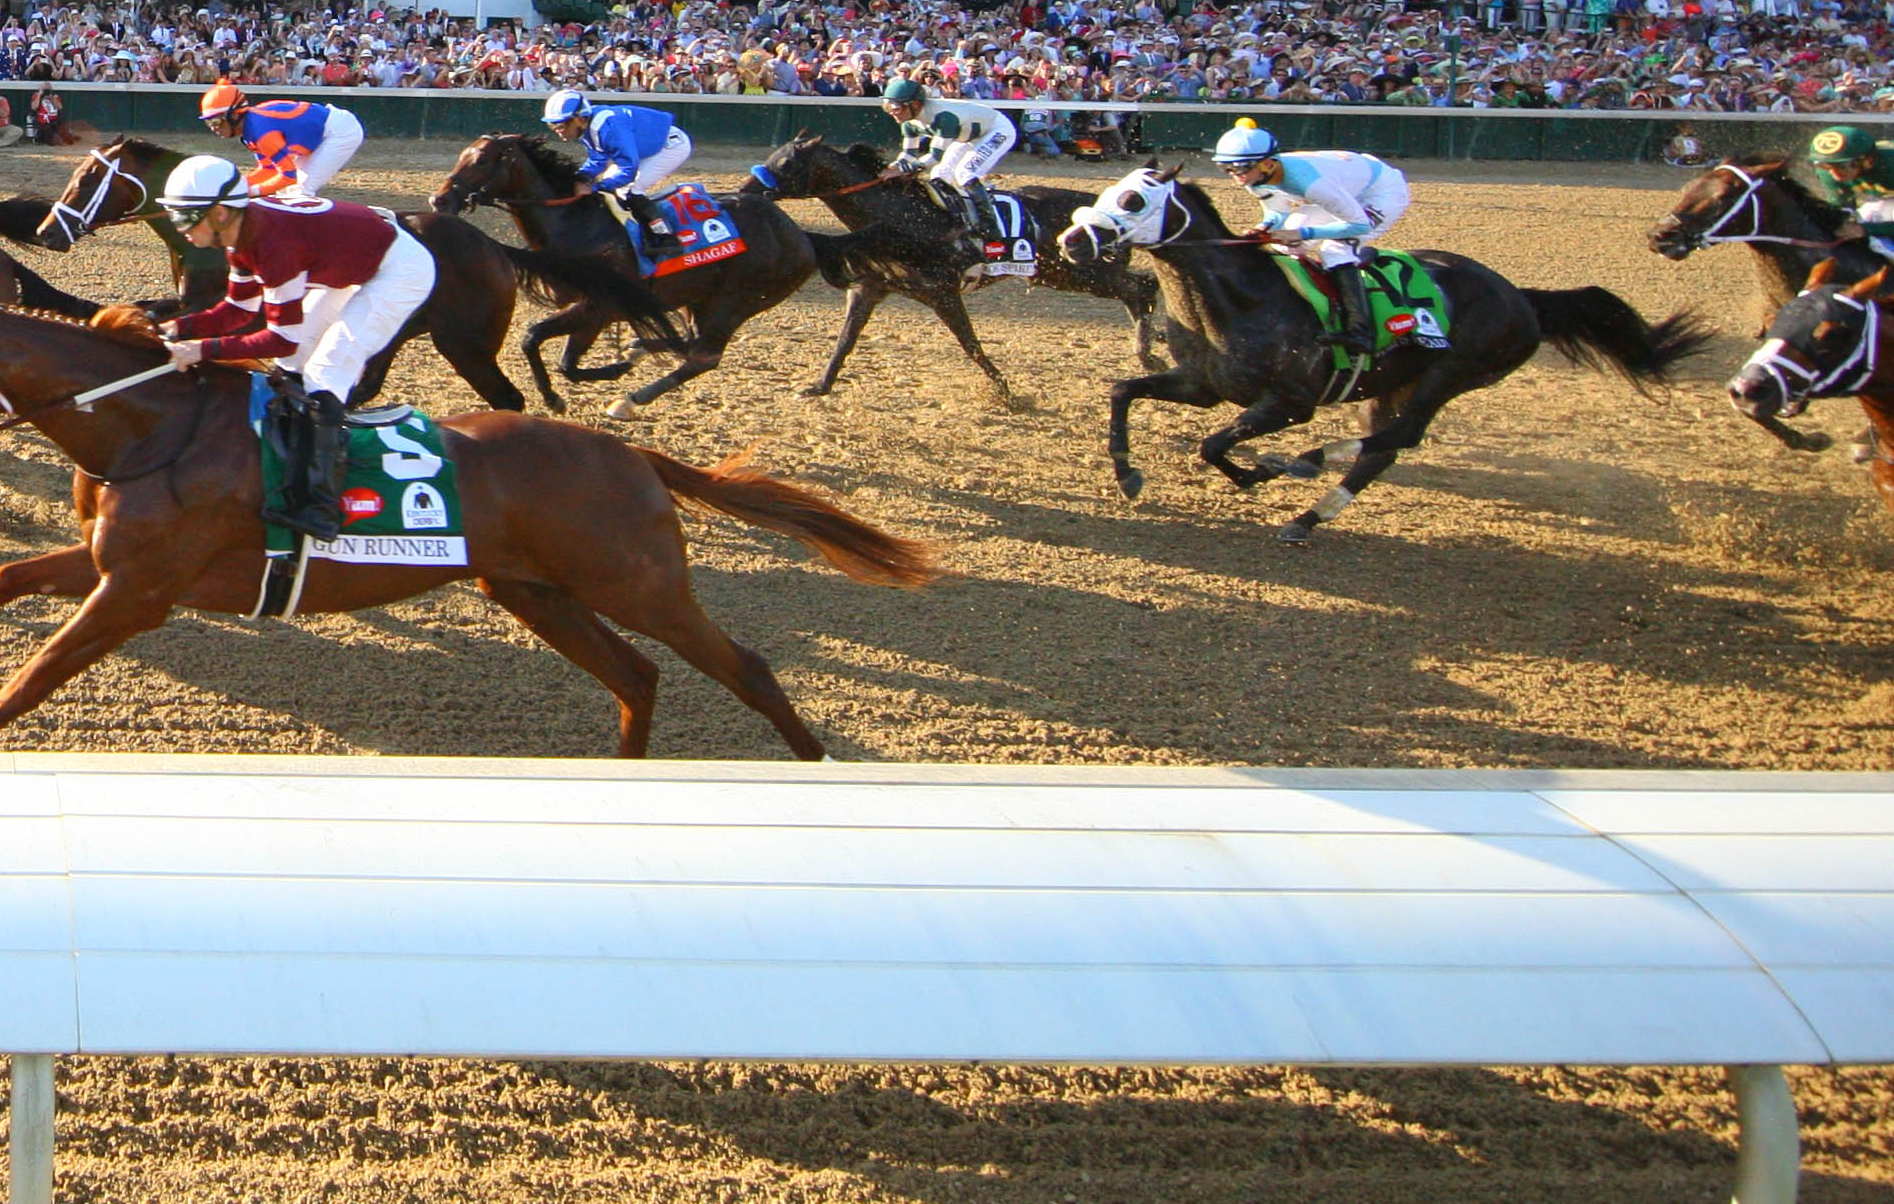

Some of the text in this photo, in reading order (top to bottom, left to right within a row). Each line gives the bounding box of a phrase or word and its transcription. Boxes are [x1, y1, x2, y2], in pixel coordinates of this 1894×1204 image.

[683, 242, 738, 266] SHAGAF
[375, 416, 444, 480] 5
[342, 495, 382, 512] Yum!
[312, 537, 450, 557] GUN RUNNER
